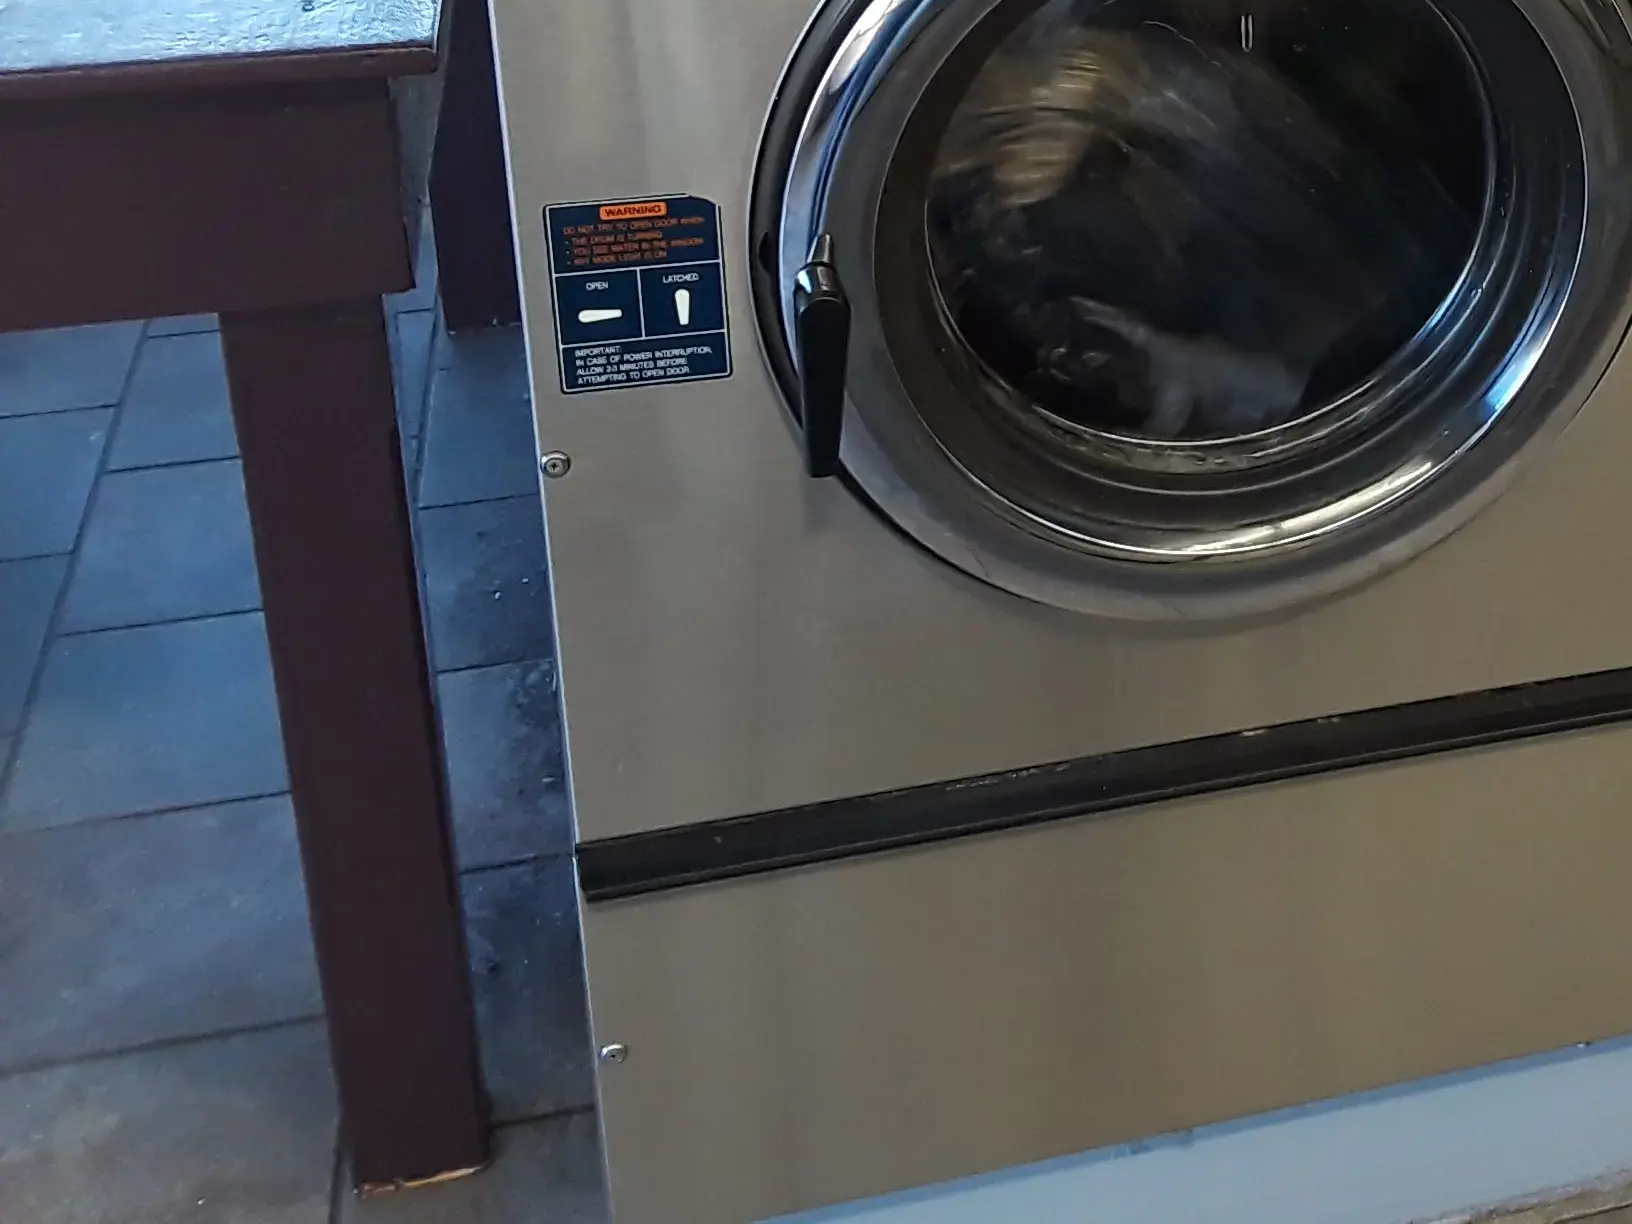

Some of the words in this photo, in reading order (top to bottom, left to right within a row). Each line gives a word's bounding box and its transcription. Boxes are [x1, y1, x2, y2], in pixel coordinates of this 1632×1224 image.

[604, 204, 662, 218] WARNING
[662, 272, 699, 284] LATCHED
[586, 280, 609, 291] OPEN
[624, 351, 653, 362] POWER
[576, 366, 604, 376] ALLOW
[620, 360, 654, 372] MINUTES
[656, 357, 688, 368] BEFORE
[577, 372, 627, 385] ATTEMPTING
[629, 371, 640, 380] TO
[642, 368, 665, 378] OPEN
[666, 365, 690, 376] DOOR
